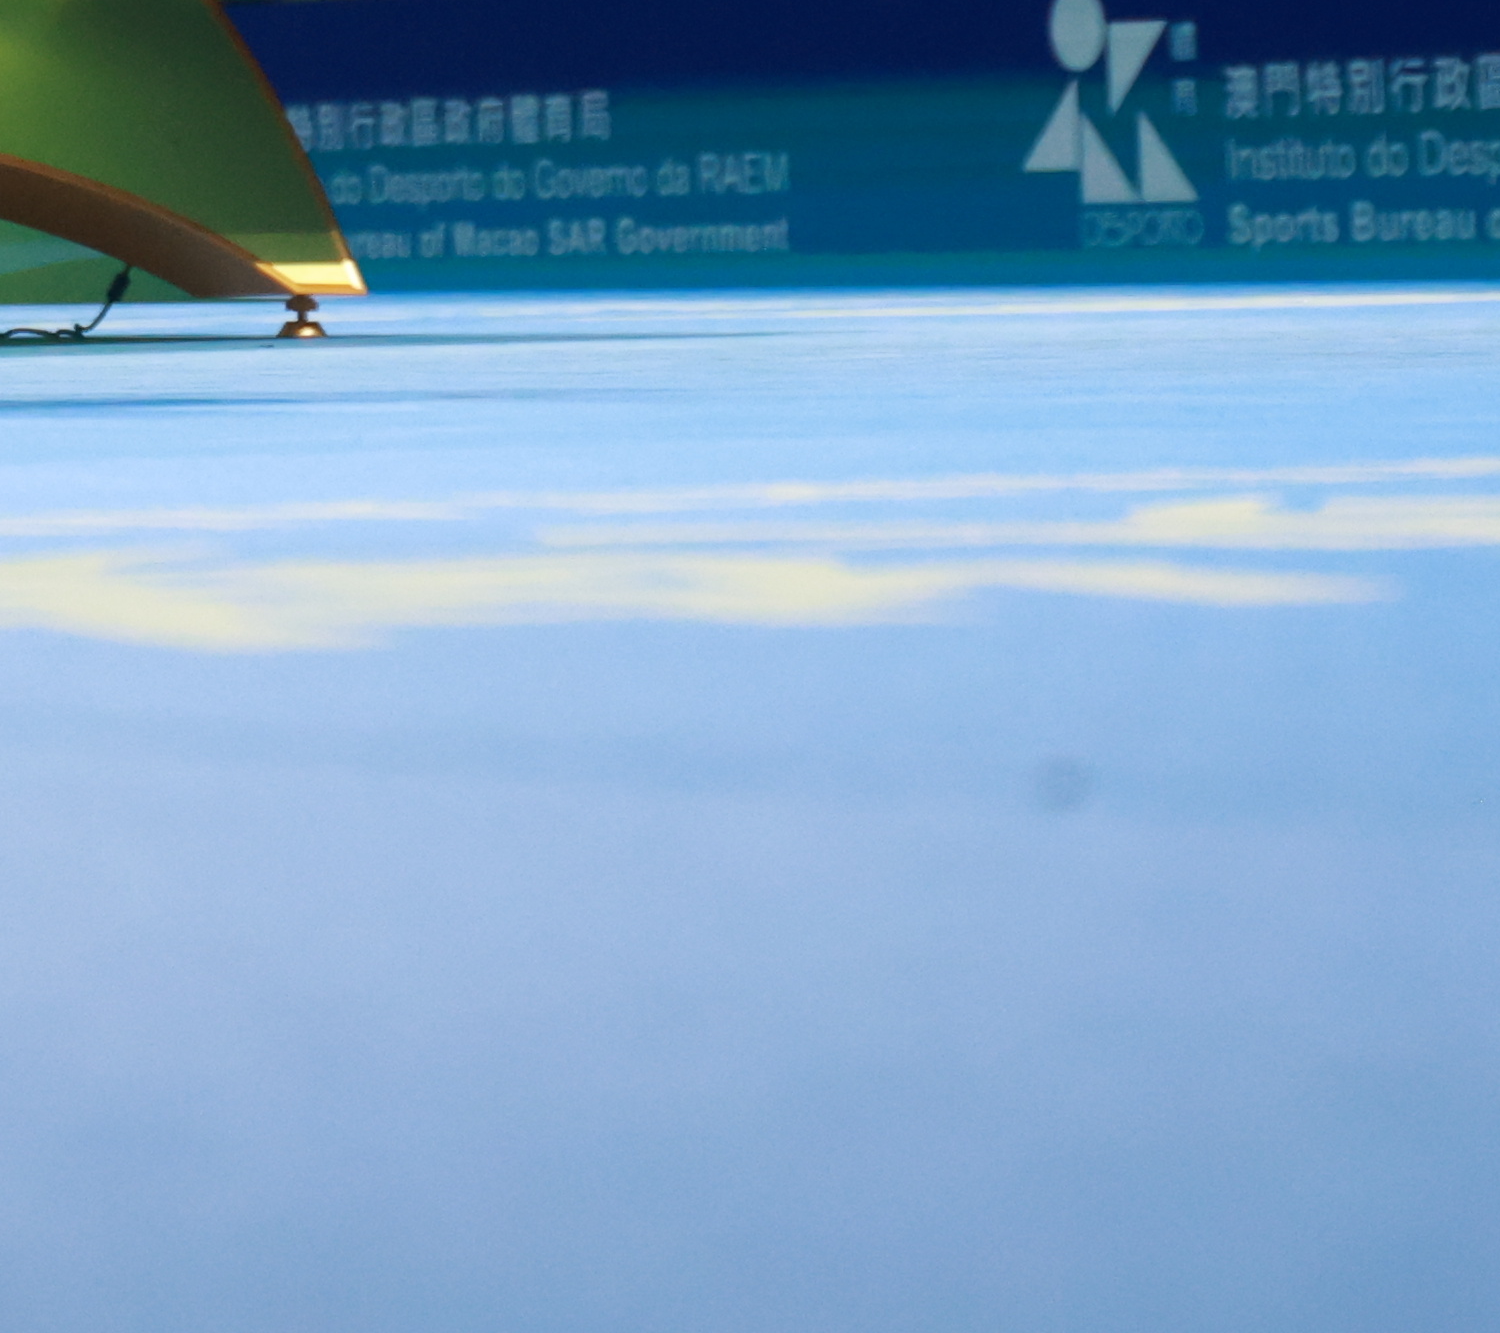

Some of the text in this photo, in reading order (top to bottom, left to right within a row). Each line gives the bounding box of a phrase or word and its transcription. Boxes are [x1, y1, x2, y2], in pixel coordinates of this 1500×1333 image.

[698, 152, 790, 194] RAEM
[1224, 136, 1357, 181] Instituto
[1364, 132, 1409, 177] do
[420, 221, 447, 258] of
[453, 220, 540, 257] Macao
[548, 217, 608, 256] SAR
[616, 215, 790, 254] Government
[1226, 202, 1341, 249] Sports
[1348, 199, 1478, 243] Bureau
